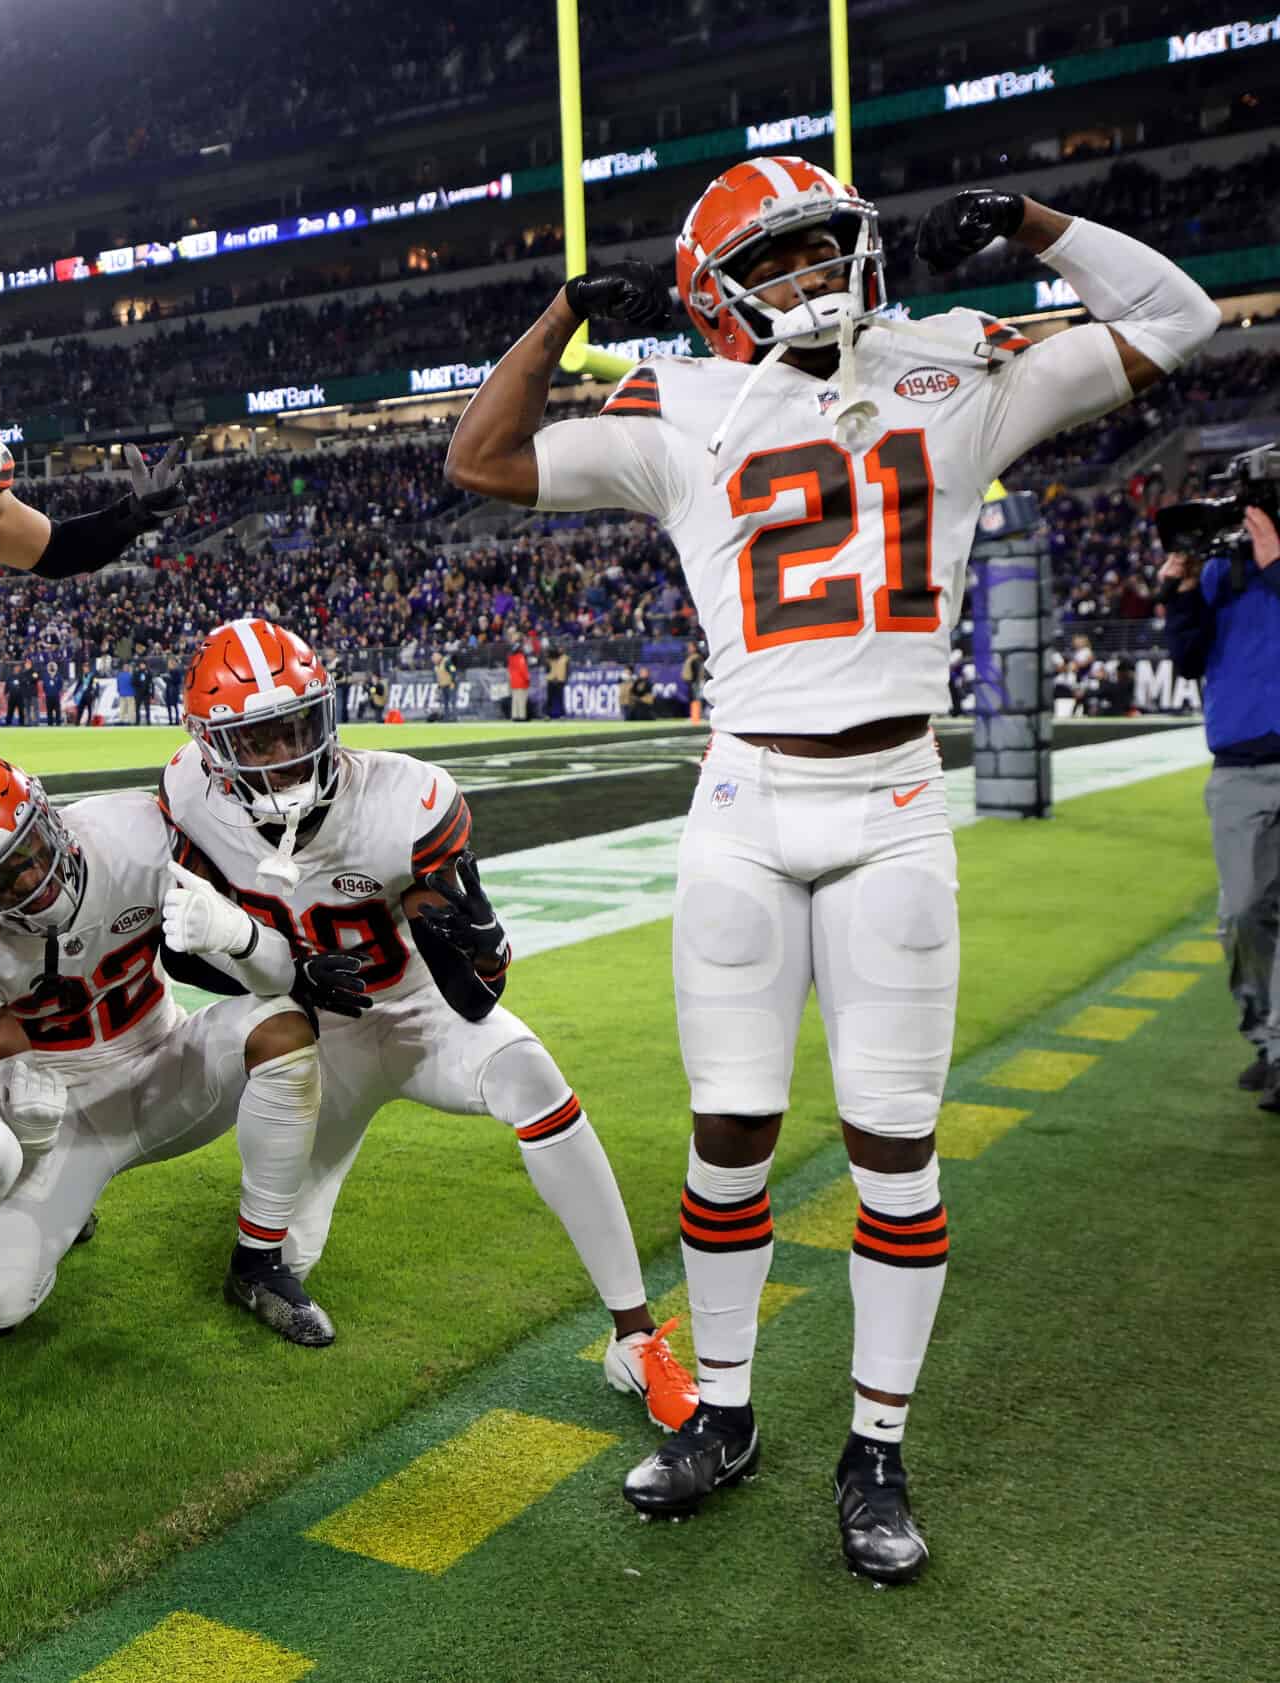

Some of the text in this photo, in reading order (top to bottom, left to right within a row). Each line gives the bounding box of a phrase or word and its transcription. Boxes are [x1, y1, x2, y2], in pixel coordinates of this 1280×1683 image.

[9, 268, 48, 288] 12:54
[417, 192, 436, 210] 47
[906, 371, 949, 397] 1946
[726, 428, 942, 653] 21
[388, 682, 471, 709] RAVES
[340, 878, 374, 893] 1946
[118, 905, 148, 931] 1946
